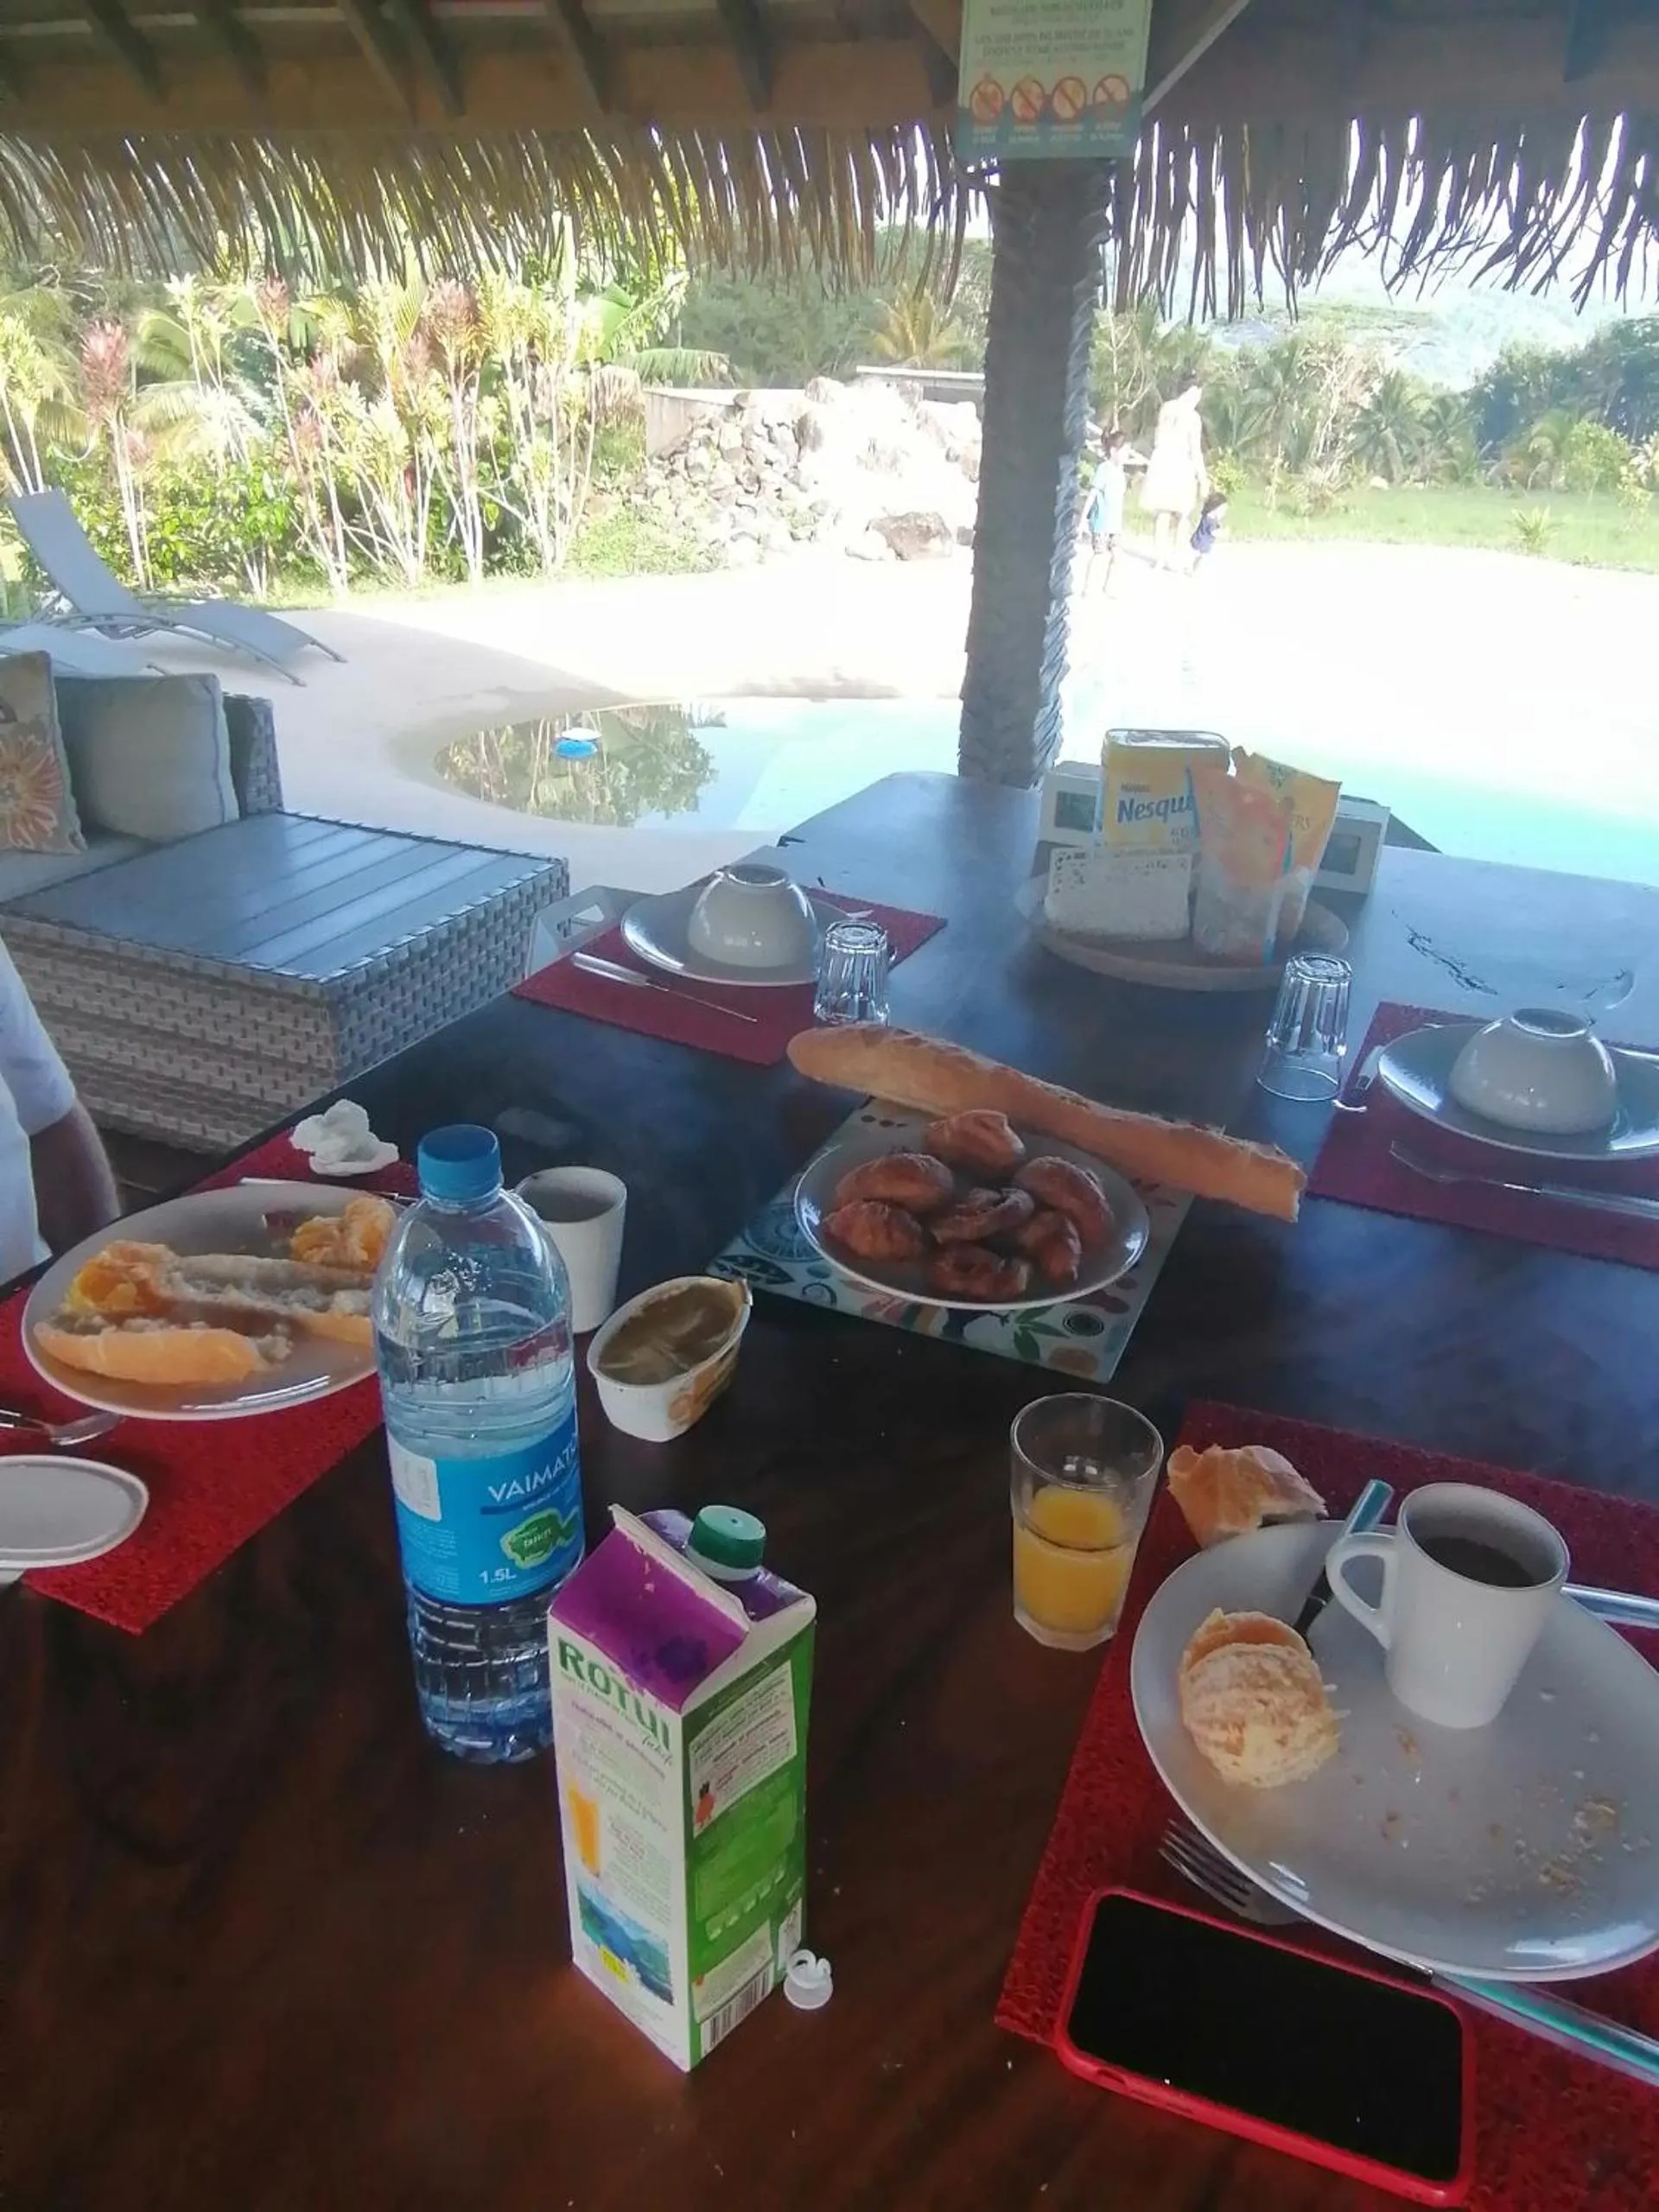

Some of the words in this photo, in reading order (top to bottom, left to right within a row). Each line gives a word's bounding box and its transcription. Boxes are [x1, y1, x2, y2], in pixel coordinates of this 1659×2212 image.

[1117, 794, 1193, 825] Nesqui
[479, 1568, 517, 1584] 1.5L
[558, 1637, 671, 1751] ROTUI
